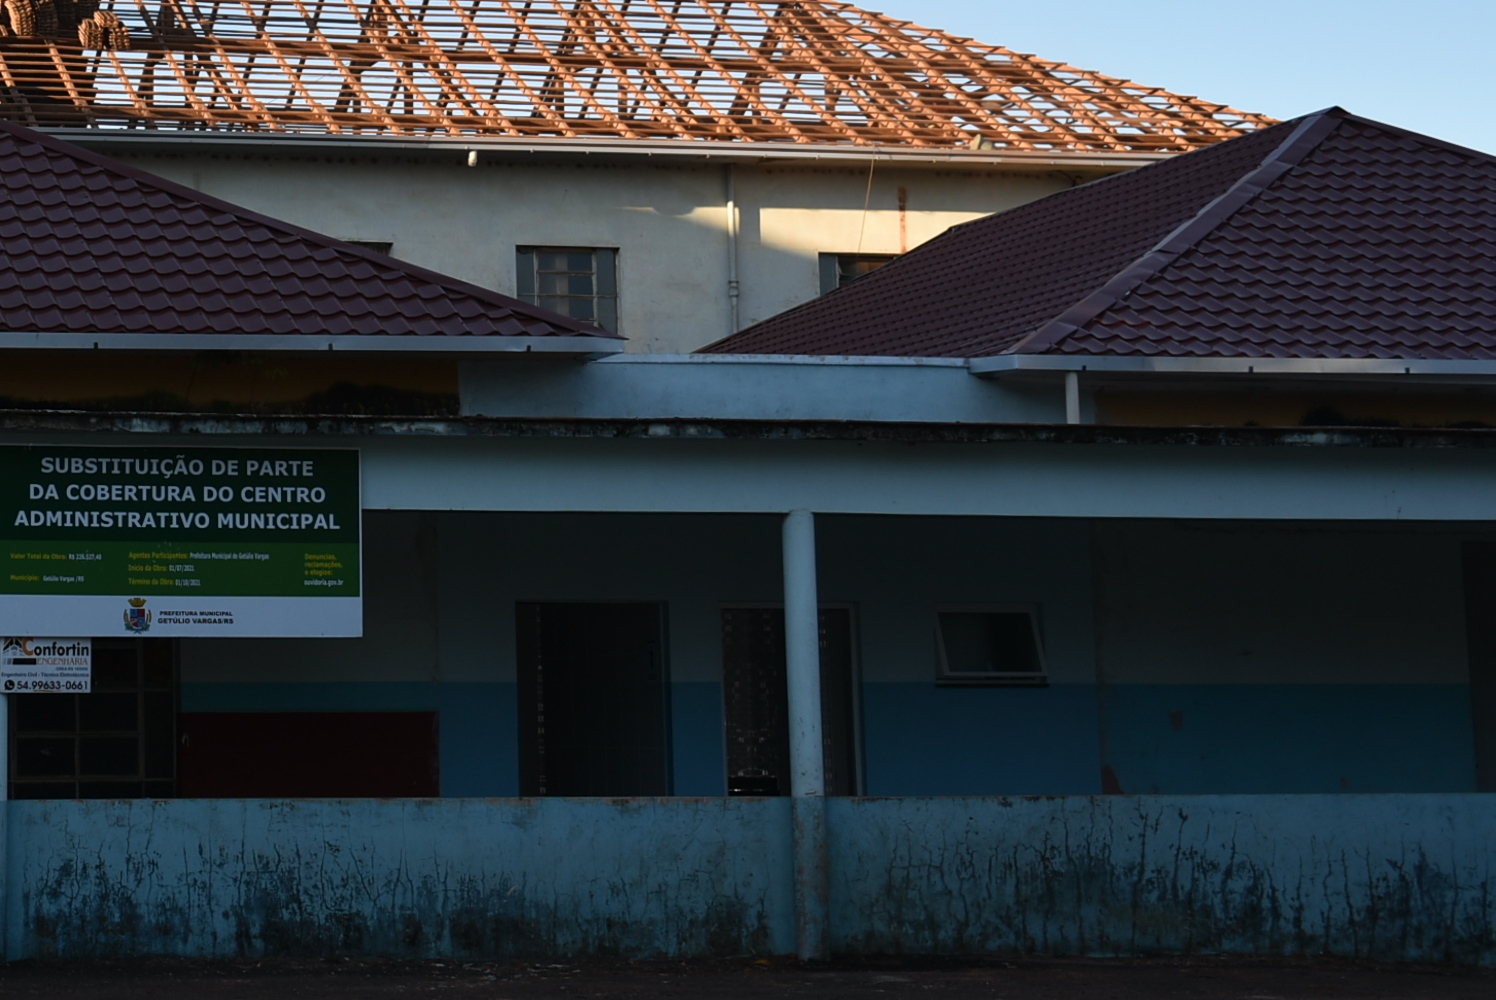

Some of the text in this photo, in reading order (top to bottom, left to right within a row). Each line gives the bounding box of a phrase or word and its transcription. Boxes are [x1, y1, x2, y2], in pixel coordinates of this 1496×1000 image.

[40, 455, 314, 478] SUBSTITUIÇÃO DE PARTE
[29, 484, 326, 503] DA COBERTURA DO CENTRO
[14, 511, 341, 530] ADMINISTRATIVO MUNICIPAL
[129, 552, 151, 560] Agentes
[152, 552, 189, 560] Participantes:
[157, 617, 191, 625] GETÚLIO
[23, 638, 89, 656] Confortin
[17, 681, 88, 690] 54.99633-0661
